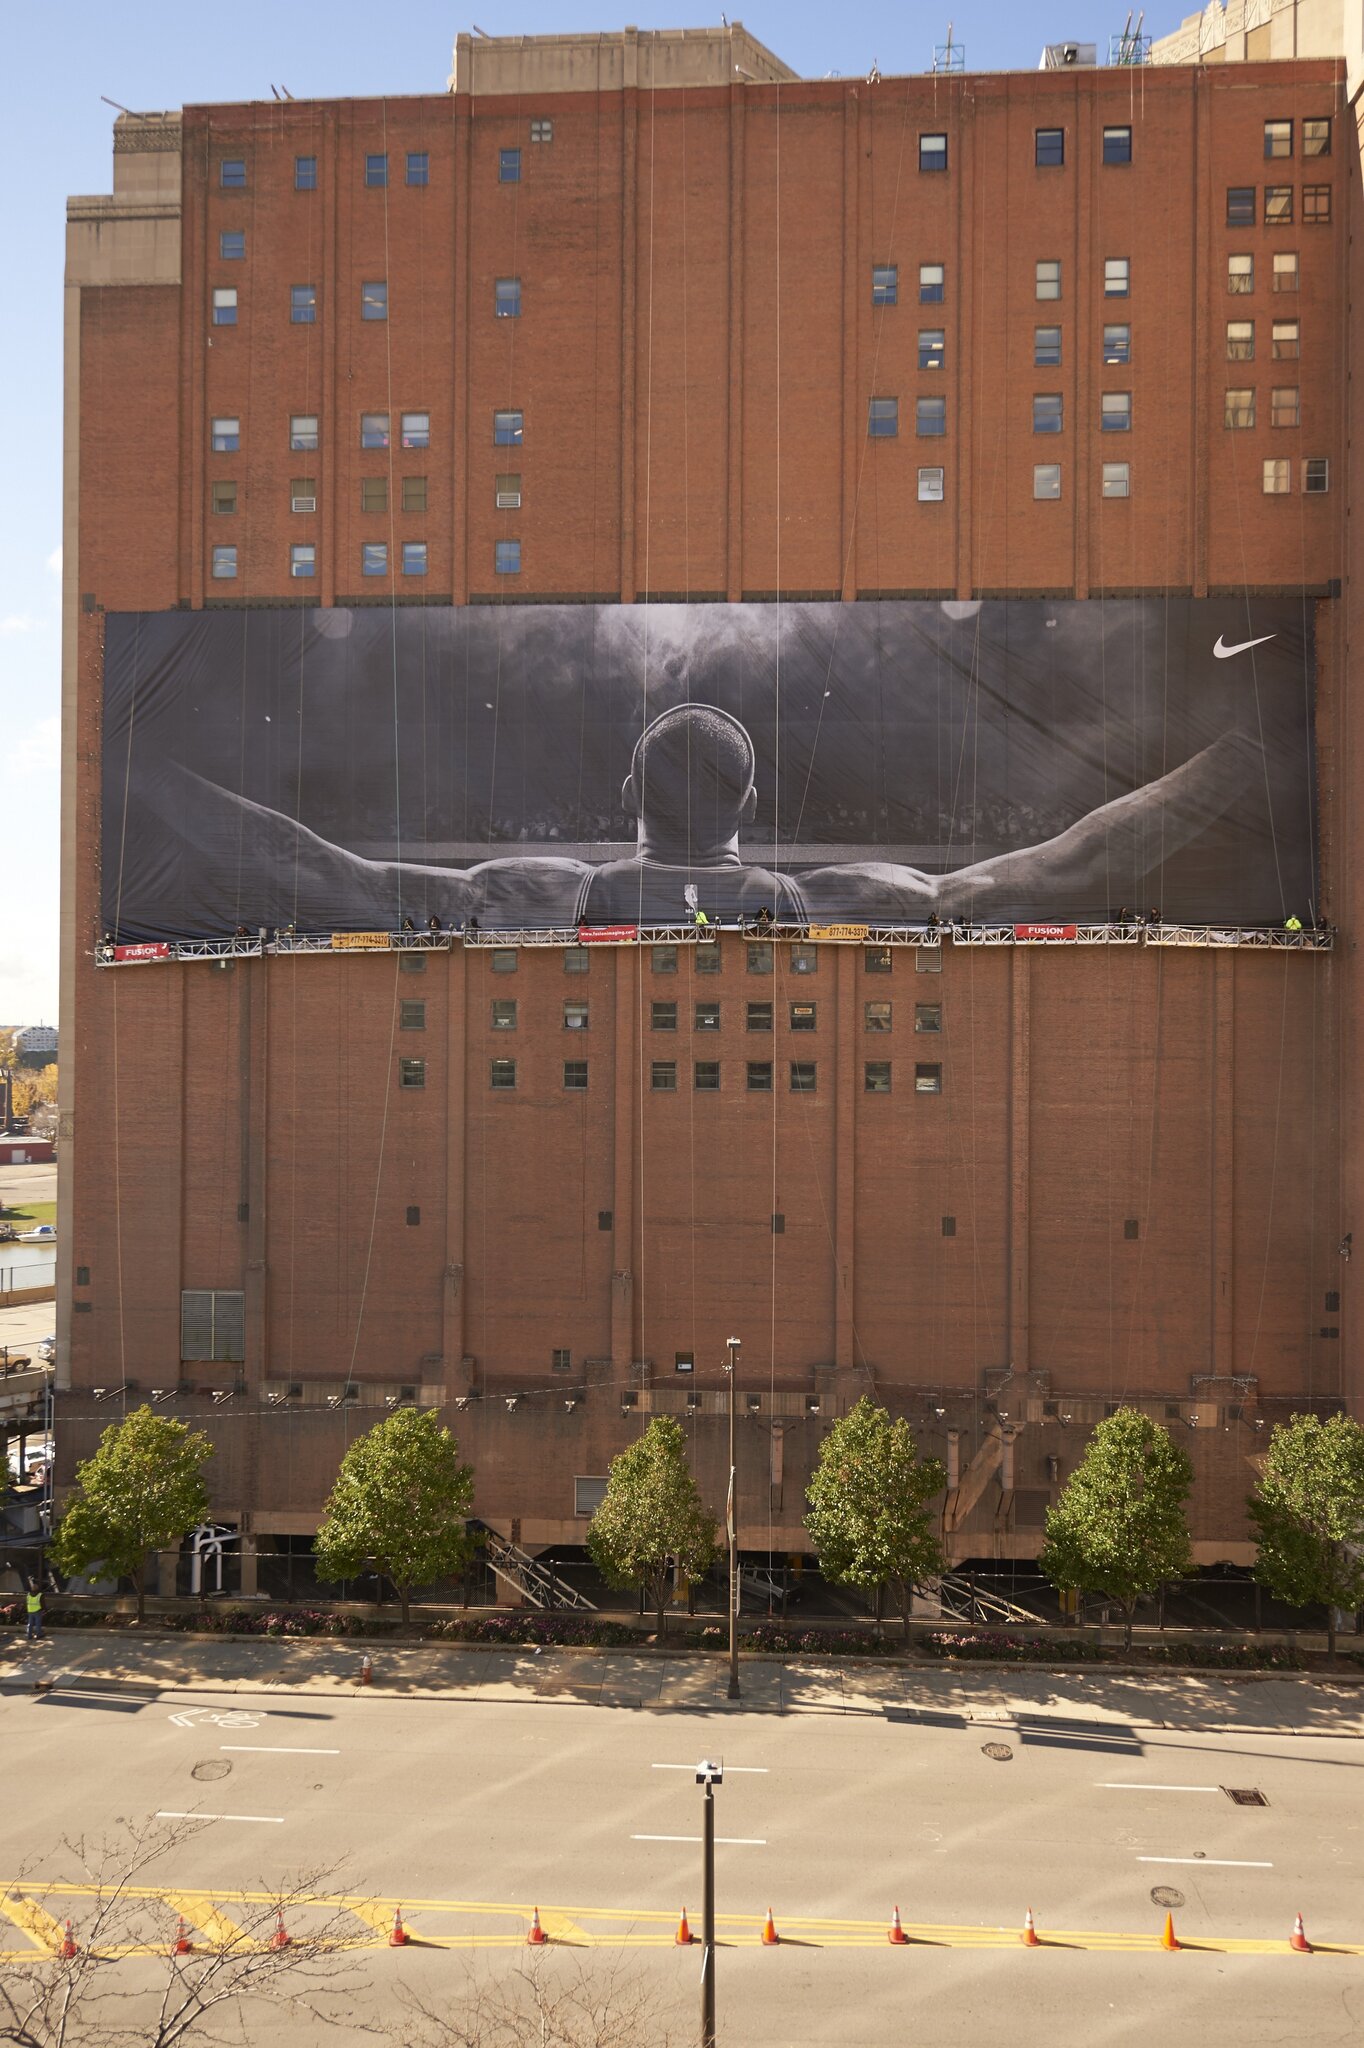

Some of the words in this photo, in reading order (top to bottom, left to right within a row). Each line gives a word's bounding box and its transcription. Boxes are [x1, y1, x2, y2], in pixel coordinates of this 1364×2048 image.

[829, 927, 867, 937] 877-774-3370
[1028, 927, 1063, 935] FUSION
[125, 947, 157, 956] FUSION
